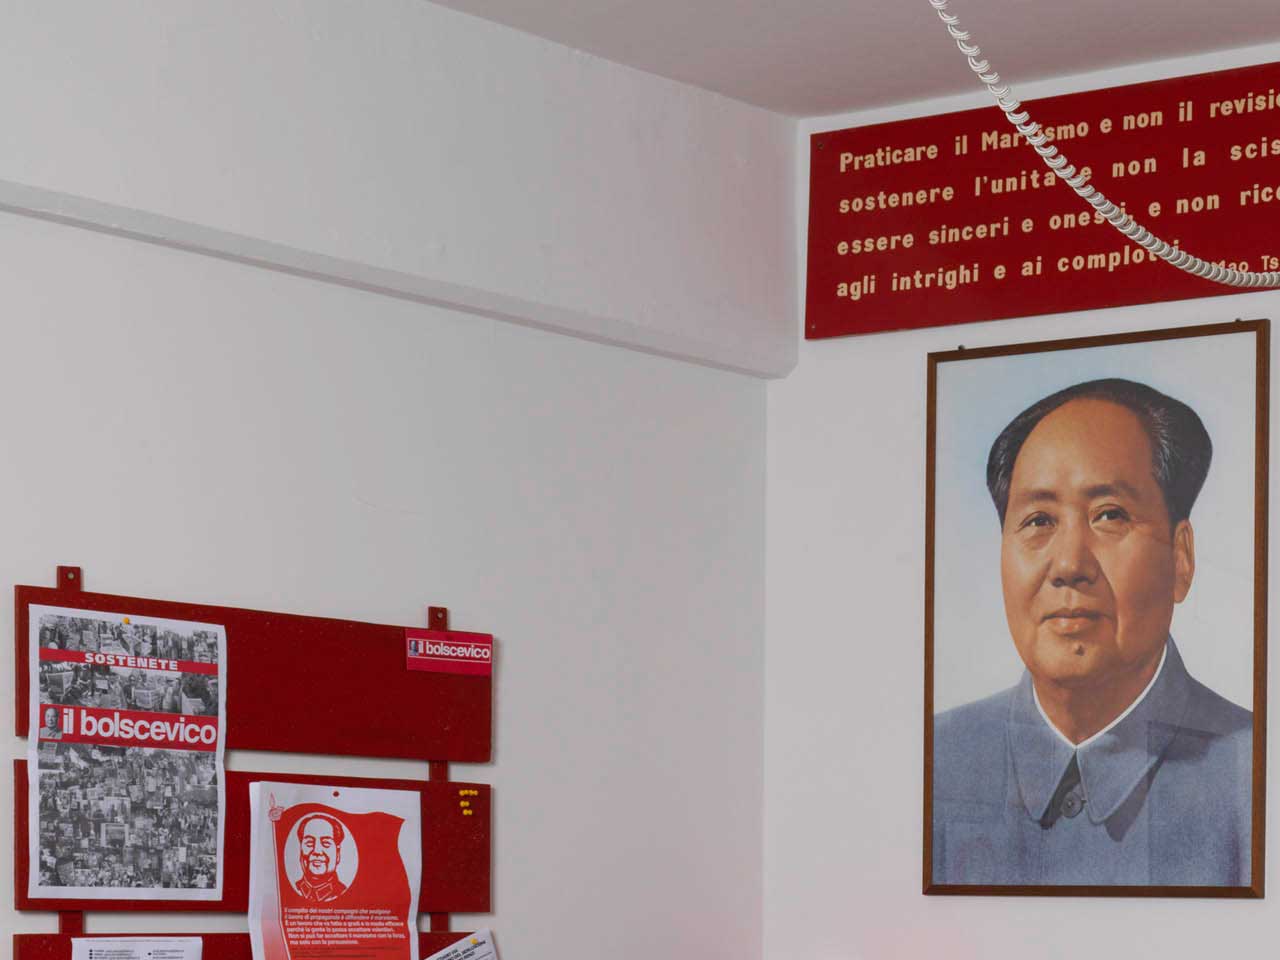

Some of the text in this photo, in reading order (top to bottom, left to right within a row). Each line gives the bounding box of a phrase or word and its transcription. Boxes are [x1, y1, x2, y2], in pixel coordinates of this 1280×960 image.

[839, 143, 939, 172] Praticare
[954, 135, 968, 155] il
[981, 120, 1089, 152] Marismo
[1100, 118, 1112, 134] e
[1122, 109, 1164, 131] non
[1178, 101, 1193, 122] il
[838, 185, 955, 214] sostenere
[1112, 157, 1158, 178] non
[1182, 147, 1206, 168] la
[836, 233, 915, 256] essere
[928, 217, 1009, 245] sinceri
[1021, 218, 1034, 232] e
[1049, 201, 1133, 231] onesi
[1148, 202, 1161, 217] e
[1176, 194, 1220, 215] non
[836, 240, 1180, 301] agli intrighi e ai complot
[84, 653, 179, 671] SOSTENETE
[418, 640, 490, 658] il bolscevico
[62, 709, 217, 745] il bolscevico
